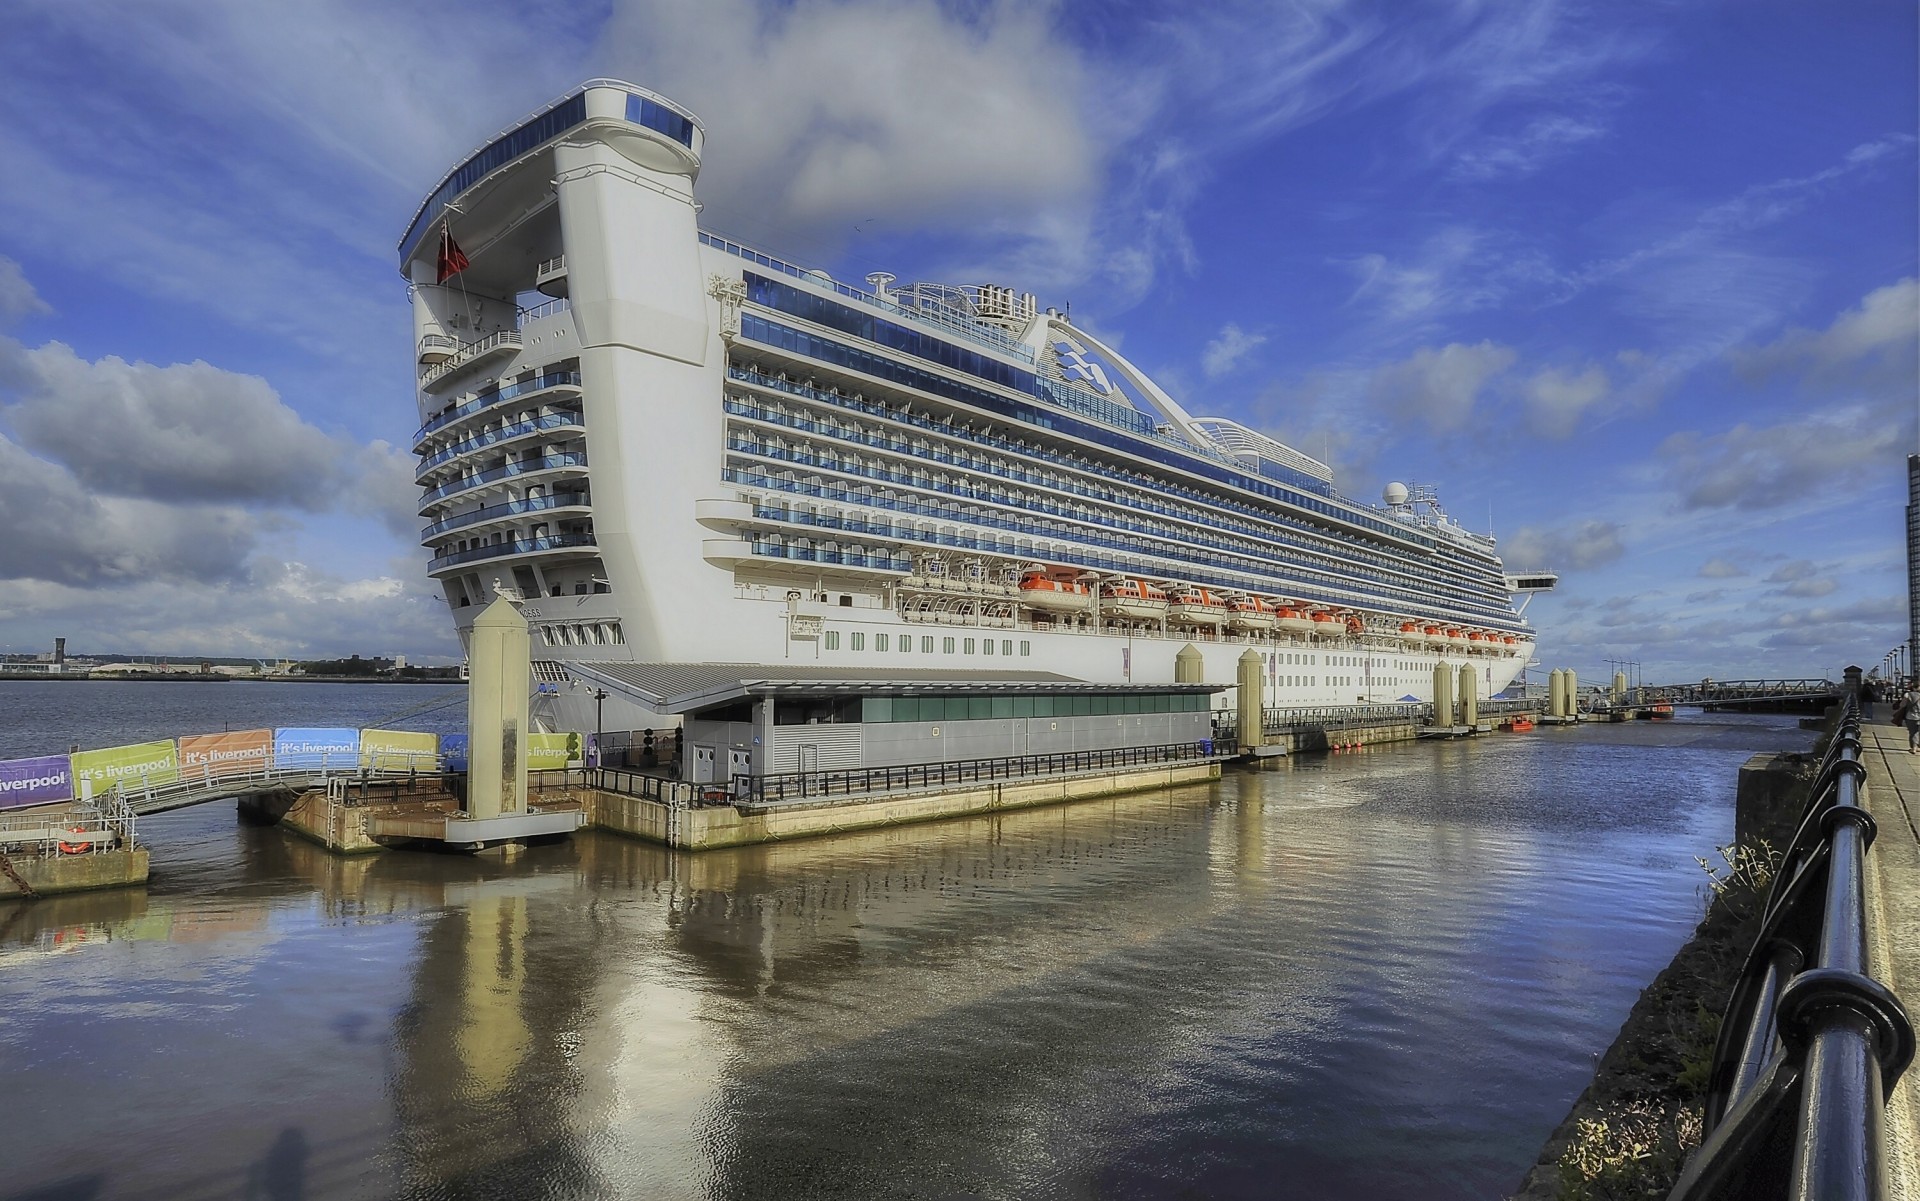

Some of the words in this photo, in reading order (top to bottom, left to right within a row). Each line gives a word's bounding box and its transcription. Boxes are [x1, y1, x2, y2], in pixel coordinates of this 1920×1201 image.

[186, 751, 208, 764] it's
[210, 744, 267, 761] liverpool
[281, 742, 300, 754] it's
[302, 742, 353, 755] liverpool
[79, 768, 104, 780] it's
[106, 756, 171, 778] liverpool
